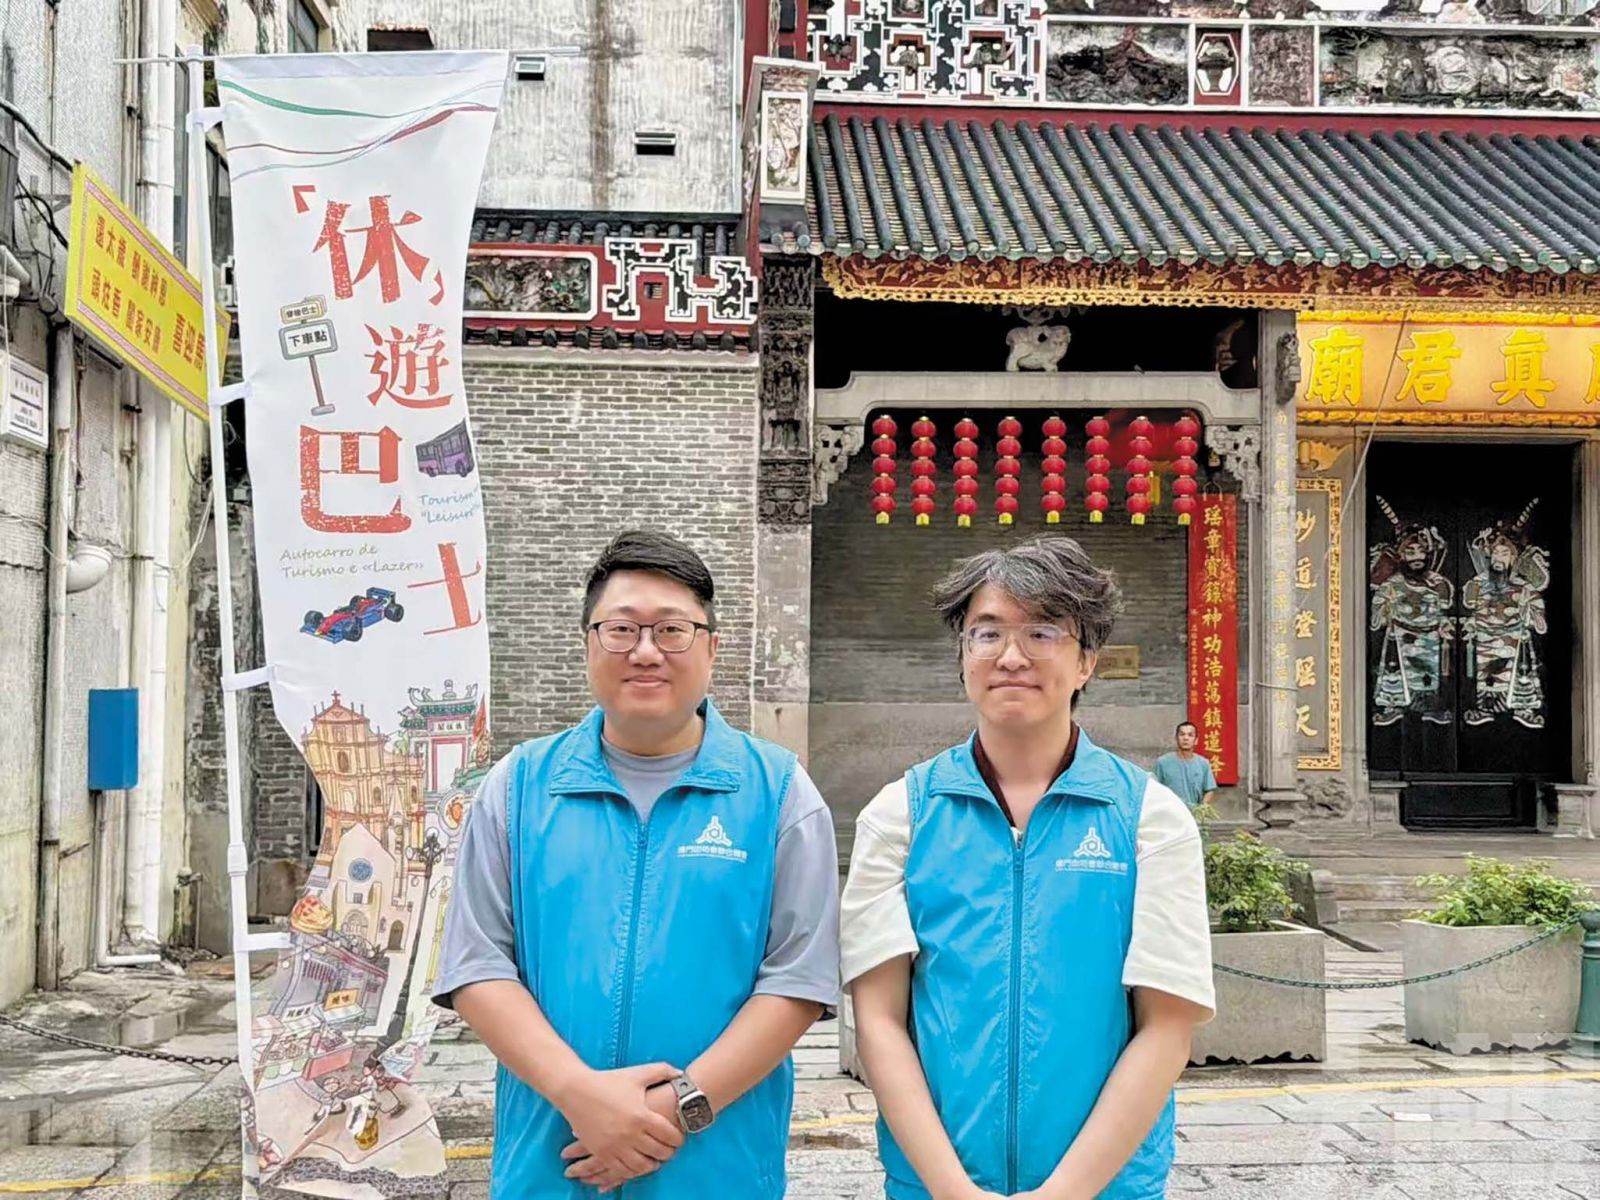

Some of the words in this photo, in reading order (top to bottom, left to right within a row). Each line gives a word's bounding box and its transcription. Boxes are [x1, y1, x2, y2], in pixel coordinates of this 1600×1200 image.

[288, 329, 328, 347] 下車點
[280, 548, 355, 561] Autocarro
[358, 543, 378, 556] de
[281, 565, 345, 579] Turismo
[349, 564, 359, 574] e
